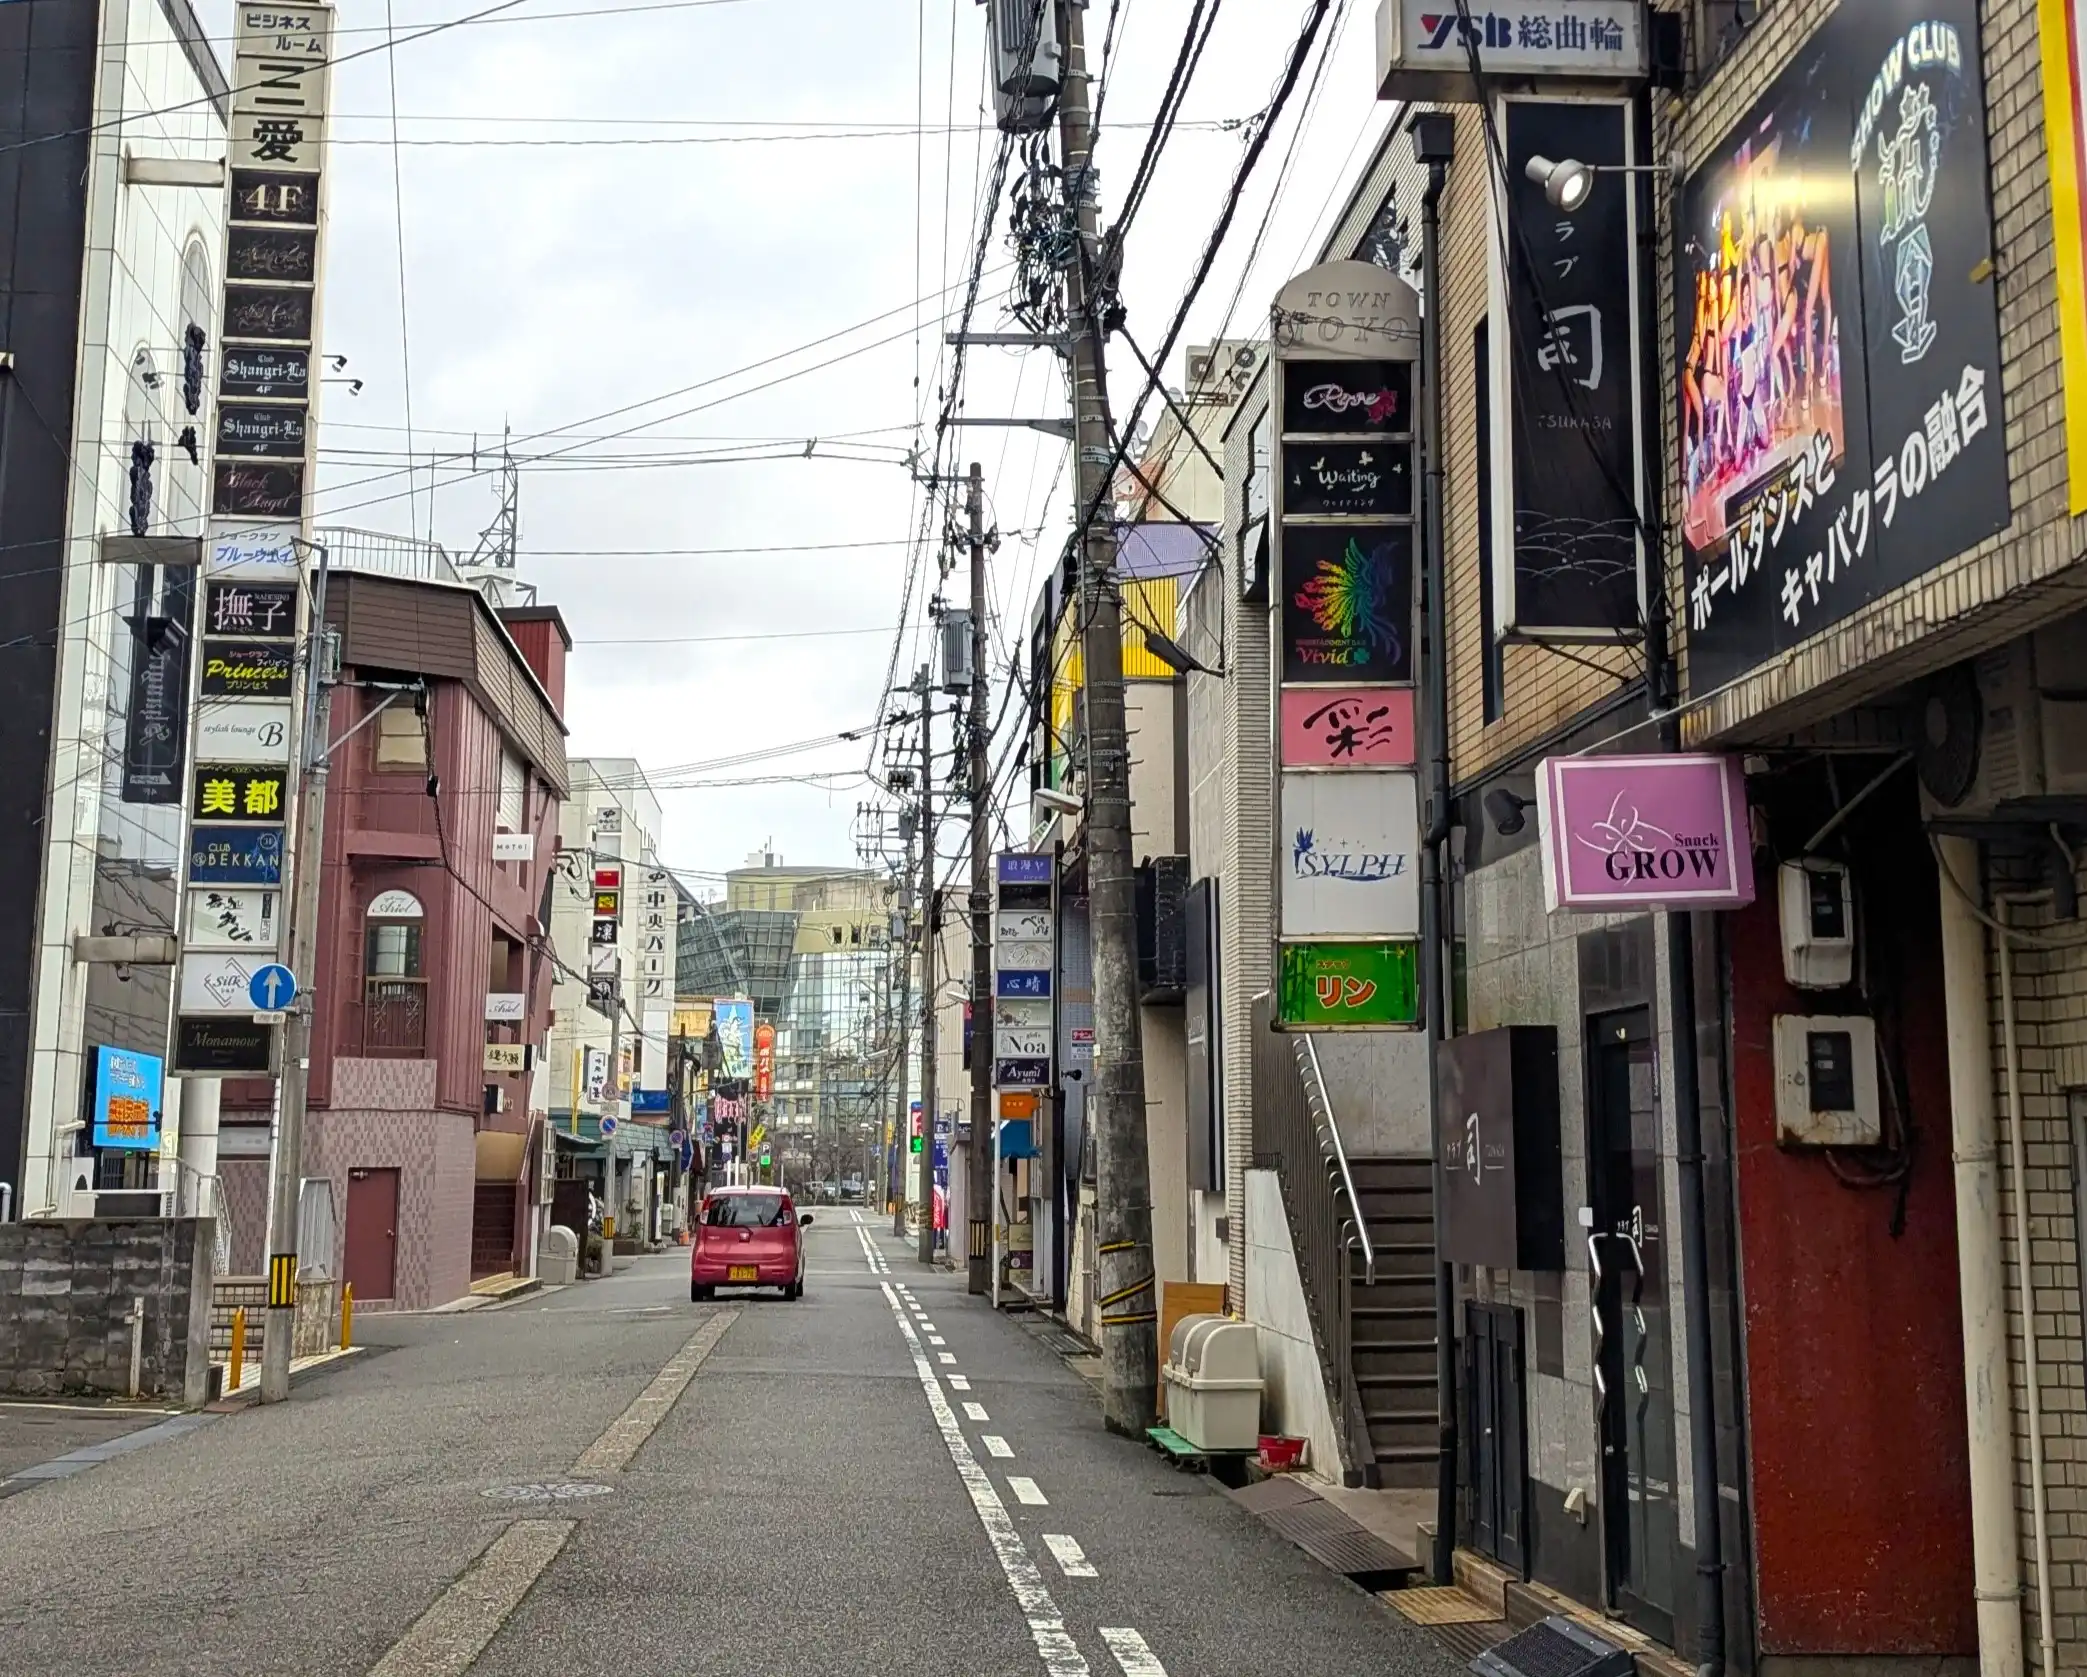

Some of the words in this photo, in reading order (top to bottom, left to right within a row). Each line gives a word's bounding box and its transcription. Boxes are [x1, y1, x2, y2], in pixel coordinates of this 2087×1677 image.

[246, 13, 311, 31] ビジネス
[1517, 14, 1624, 51] 総曲輪
[275, 35, 323, 54] ルーム
[1850, 37, 1906, 173] SHOW
[1906, 20, 1963, 73] CLUB
[245, 184, 303, 212] 4F
[1306, 291, 1391, 308] TOWN
[1537, 304, 1603, 391] 司
[257, 355, 275, 364] Club
[223, 359, 307, 383] Shangri-La
[255, 385, 273, 394] 4F
[218, 418, 304, 441] Shangri-La
[252, 443, 269, 453] 4F
[1318, 469, 1382, 490] Waiting
[1781, 362, 1991, 627] キャバクラの融合
[218, 531, 281, 542] ショークラブ
[1691, 428, 1836, 631] ポールダンスと
[213, 587, 288, 632] 撫子
[1295, 646, 1356, 665] Vivid
[205, 659, 290, 681] Princess
[225, 680, 269, 690] プリンセス
[257, 721, 284, 747] B
[201, 778, 280, 815] 美都
[207, 842, 232, 853] CLUB
[1674, 832, 1720, 848] Snack
[207, 853, 280, 867] BEKKAN
[1300, 853, 1407, 877] SYLPH
[1605, 848, 1721, 881] GROW
[646, 890, 665, 996] 中央パーク
[213, 975, 245, 989] Silk
[1315, 975, 1378, 1010] リン
[188, 1031, 261, 1049] Monamour
[1007, 1034, 1047, 1055] Noa
[1006, 1065, 1041, 1079] Ayumi
